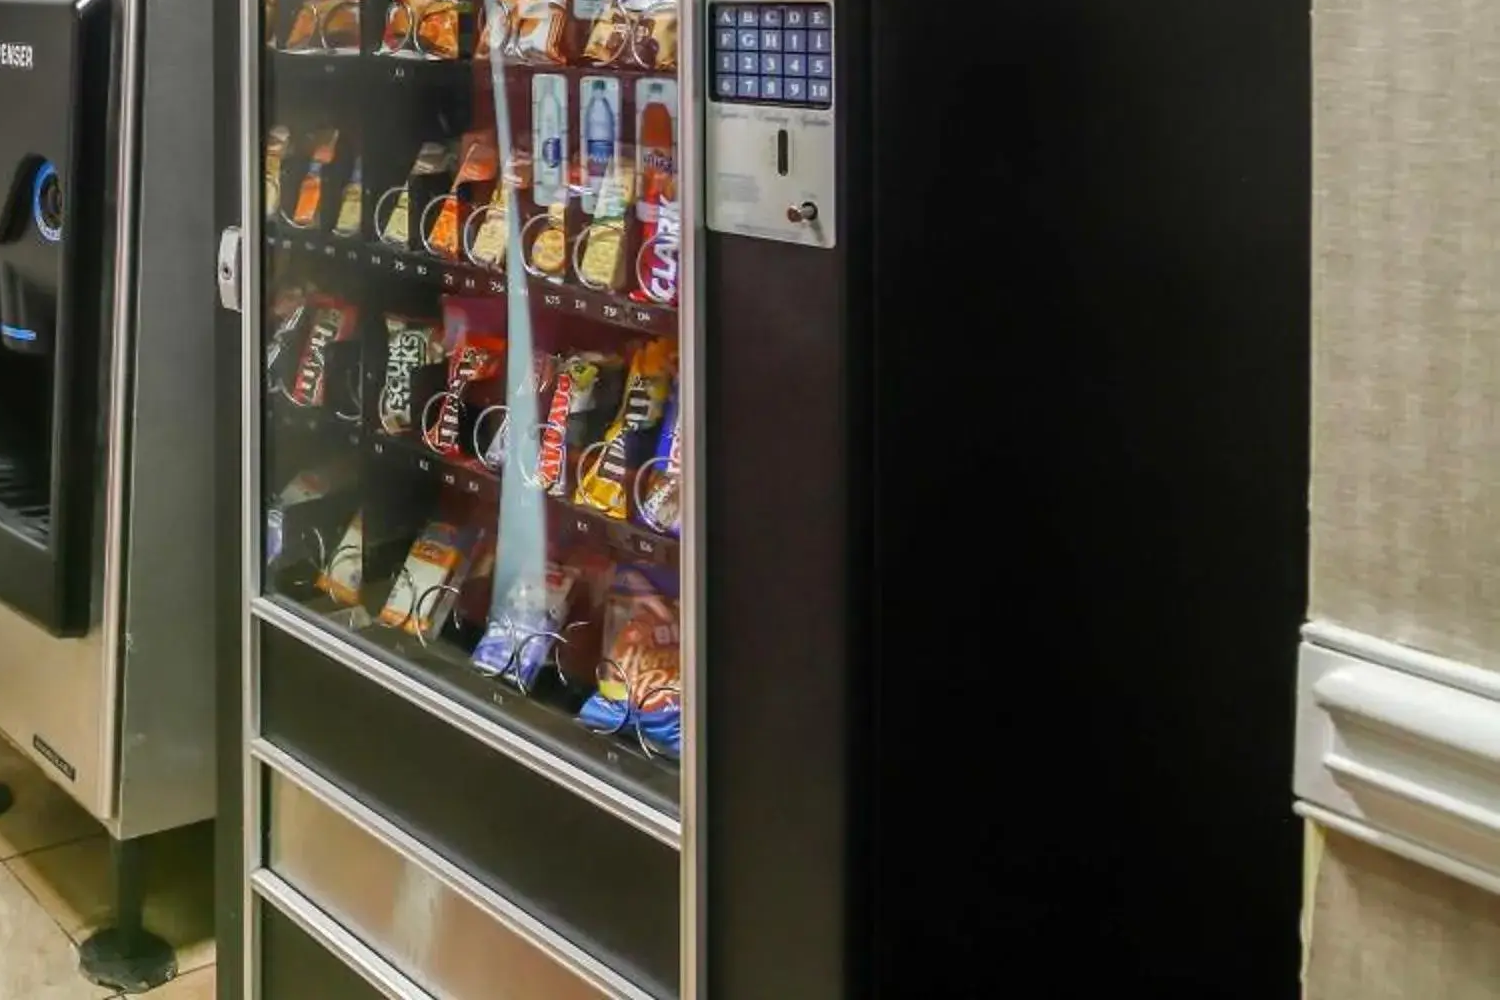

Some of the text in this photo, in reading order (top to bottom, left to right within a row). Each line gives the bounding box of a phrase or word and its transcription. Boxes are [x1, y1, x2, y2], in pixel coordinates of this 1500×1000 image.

[722, 11, 731, 23] A
[765, 11, 777, 22] C
[789, 11, 800, 24] D
[813, 11, 824, 25] E
[722, 33, 731, 47] F
[742, 34, 756, 47] G
[765, 33, 777, 48] H
[744, 57, 754, 70] 2
[766, 58, 776, 72] 3
[790, 60, 799, 73] 4
[814, 61, 824, 74] 5
[744, 81, 754, 93] 7
[790, 84, 800, 97] 9
[811, 85, 828, 98] 10
